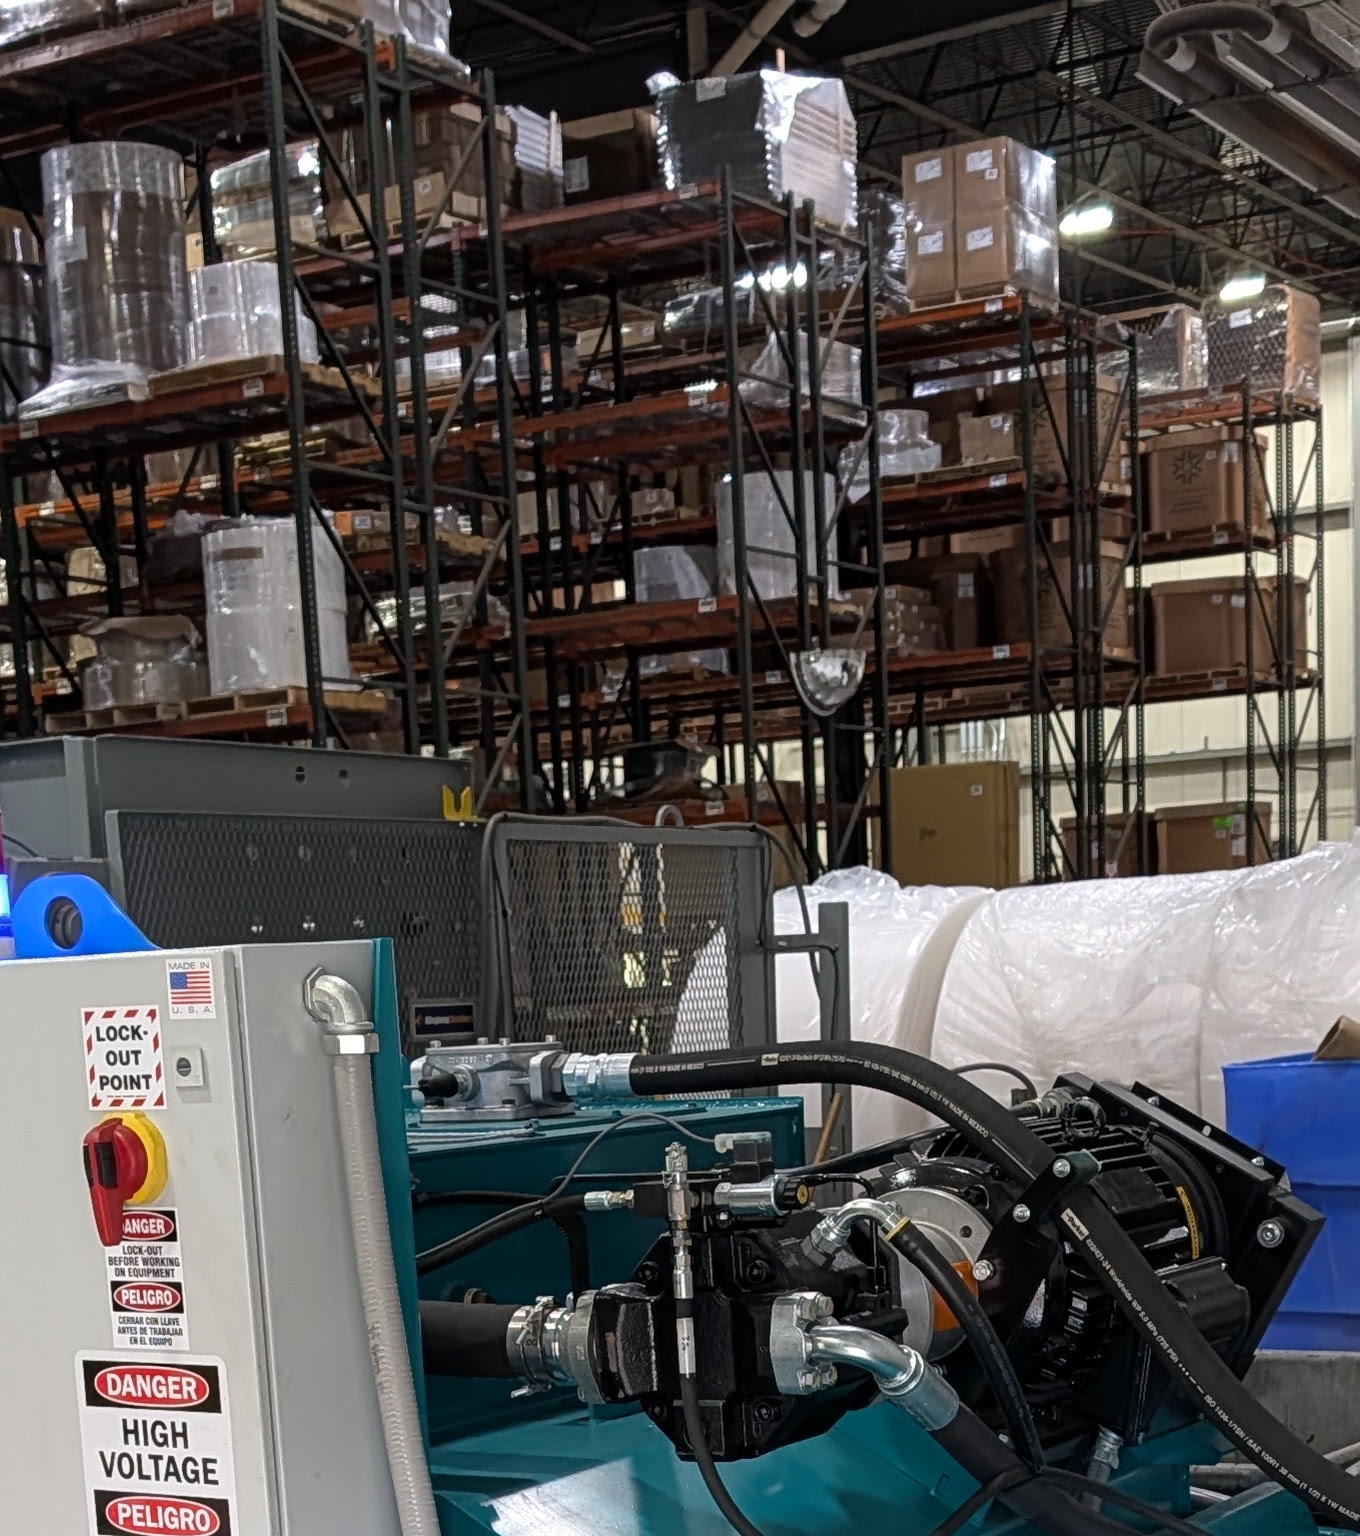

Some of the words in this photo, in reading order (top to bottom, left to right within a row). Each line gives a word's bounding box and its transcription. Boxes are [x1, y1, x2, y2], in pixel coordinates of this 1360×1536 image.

[168, 962, 195, 970] MADE
[200, 961, 210, 969] IN
[95, 1025, 148, 1042] LOCK-
[105, 1050, 142, 1066] OUT
[99, 1074, 152, 1091] POINT
[123, 1218, 166, 1235] ANGER
[122, 1246, 163, 1256] LOCK-OUT
[108, 1256, 139, 1267] BEFORE
[141, 1257, 180, 1267] WORKING
[115, 1268, 126, 1277] ON
[128, 1268, 175, 1278] EQUIPMENT
[121, 1289, 173, 1305] PELIGRO
[161, 1317, 180, 1326] LLAVE
[118, 1327, 138, 1335] ANTES
[140, 1327, 148, 1335] DE
[149, 1328, 183, 1336] TRABAJAR
[129, 1337, 138, 1345] EN
[140, 1337, 147, 1345] EL
[149, 1337, 173, 1346] EQUIPO
[106, 1373, 198, 1401] DANGER
[122, 1418, 189, 1449] HIGH
[1204, 1394, 1216, 1408] ISO
[1247, 1438, 1261, 1454] SAE
[1338, 1505, 1360, 1522] MADE
[99, 1450, 220, 1486] VOLTAGE
[117, 1503, 211, 1532] PELIGRO
